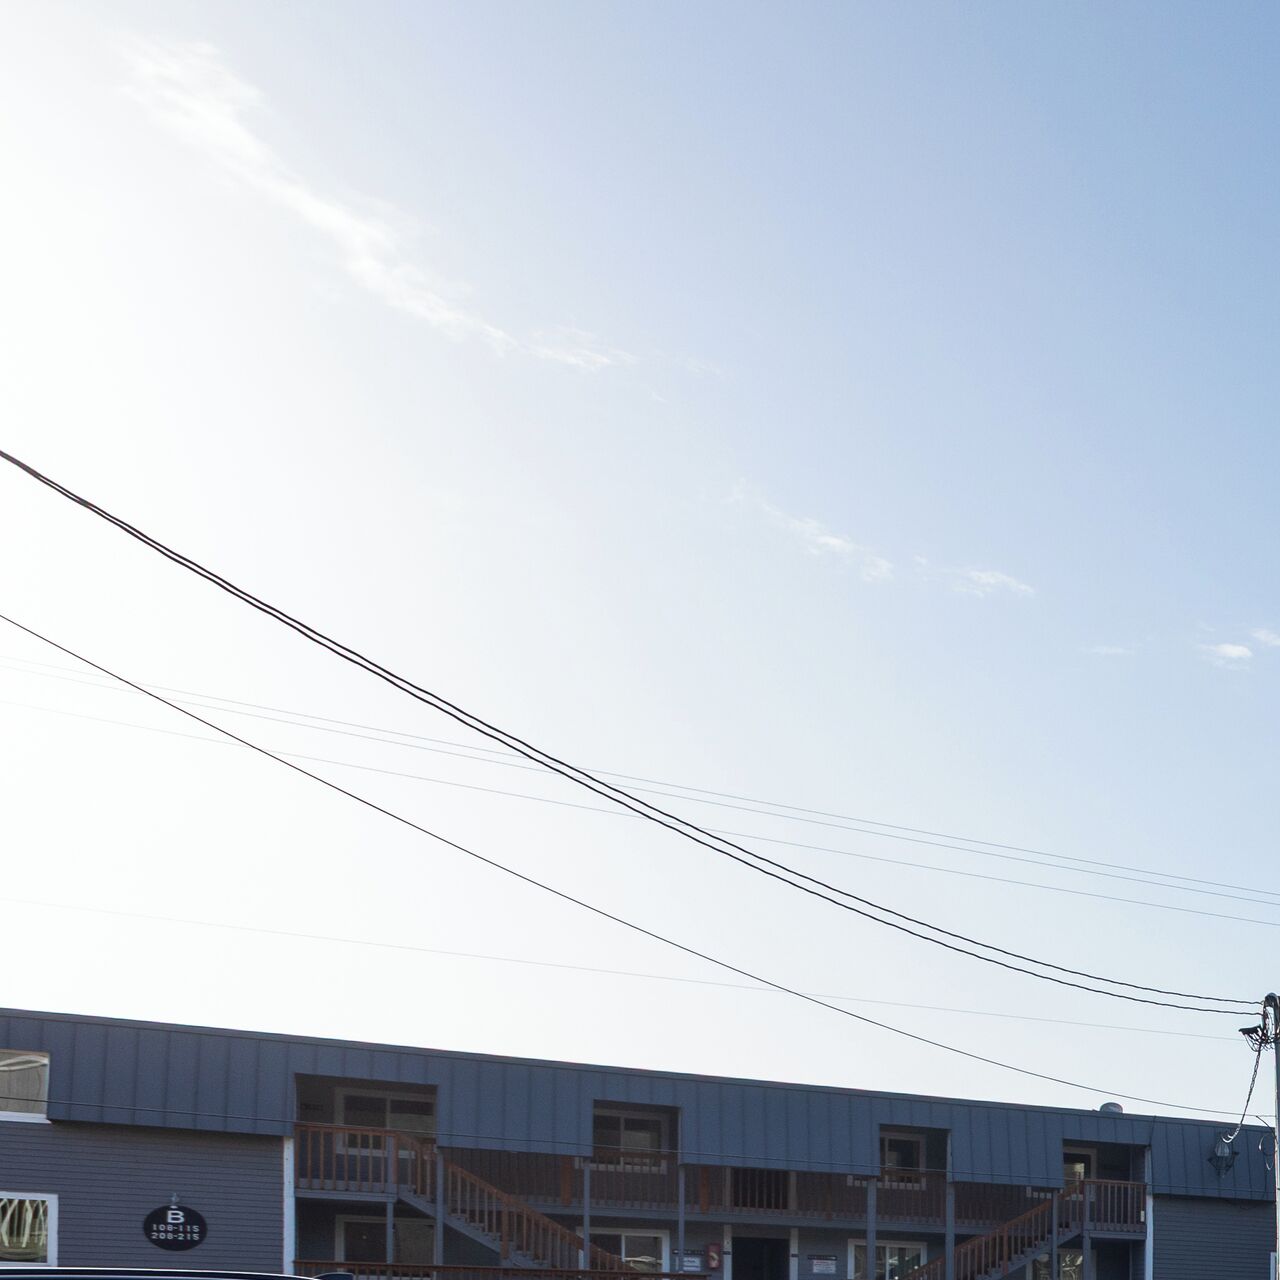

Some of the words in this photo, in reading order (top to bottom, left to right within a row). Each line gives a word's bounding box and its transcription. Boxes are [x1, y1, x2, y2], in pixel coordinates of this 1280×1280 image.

[167, 1210, 185, 1223] B
[152, 1224, 200, 1232] 108-115
[151, 1232, 200, 1240] 208-215
